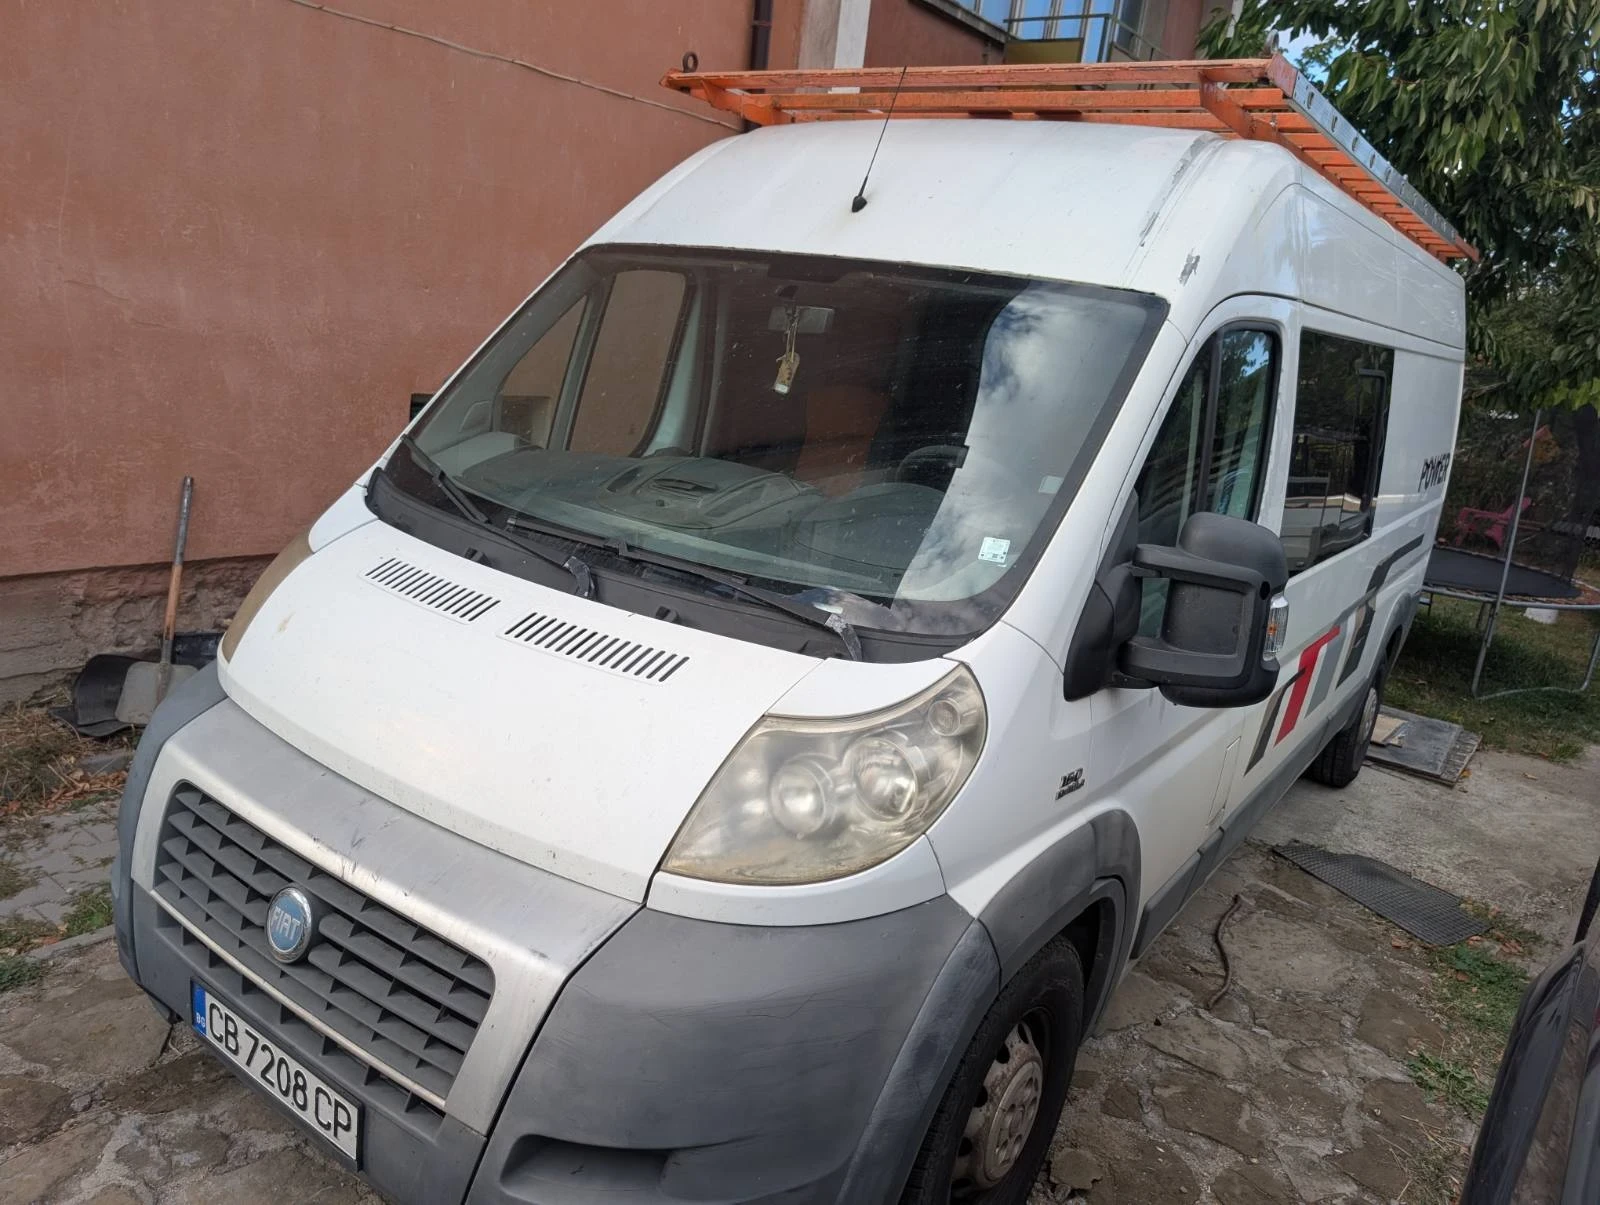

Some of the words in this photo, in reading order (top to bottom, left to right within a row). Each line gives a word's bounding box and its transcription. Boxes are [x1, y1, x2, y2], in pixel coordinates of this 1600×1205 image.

[271, 906, 301, 940] FIAT
[196, 1012, 206, 1028] BG
[209, 1002, 239, 1056] CB
[245, 1028, 308, 1112] 7208
[314, 1086, 352, 1139] CP
